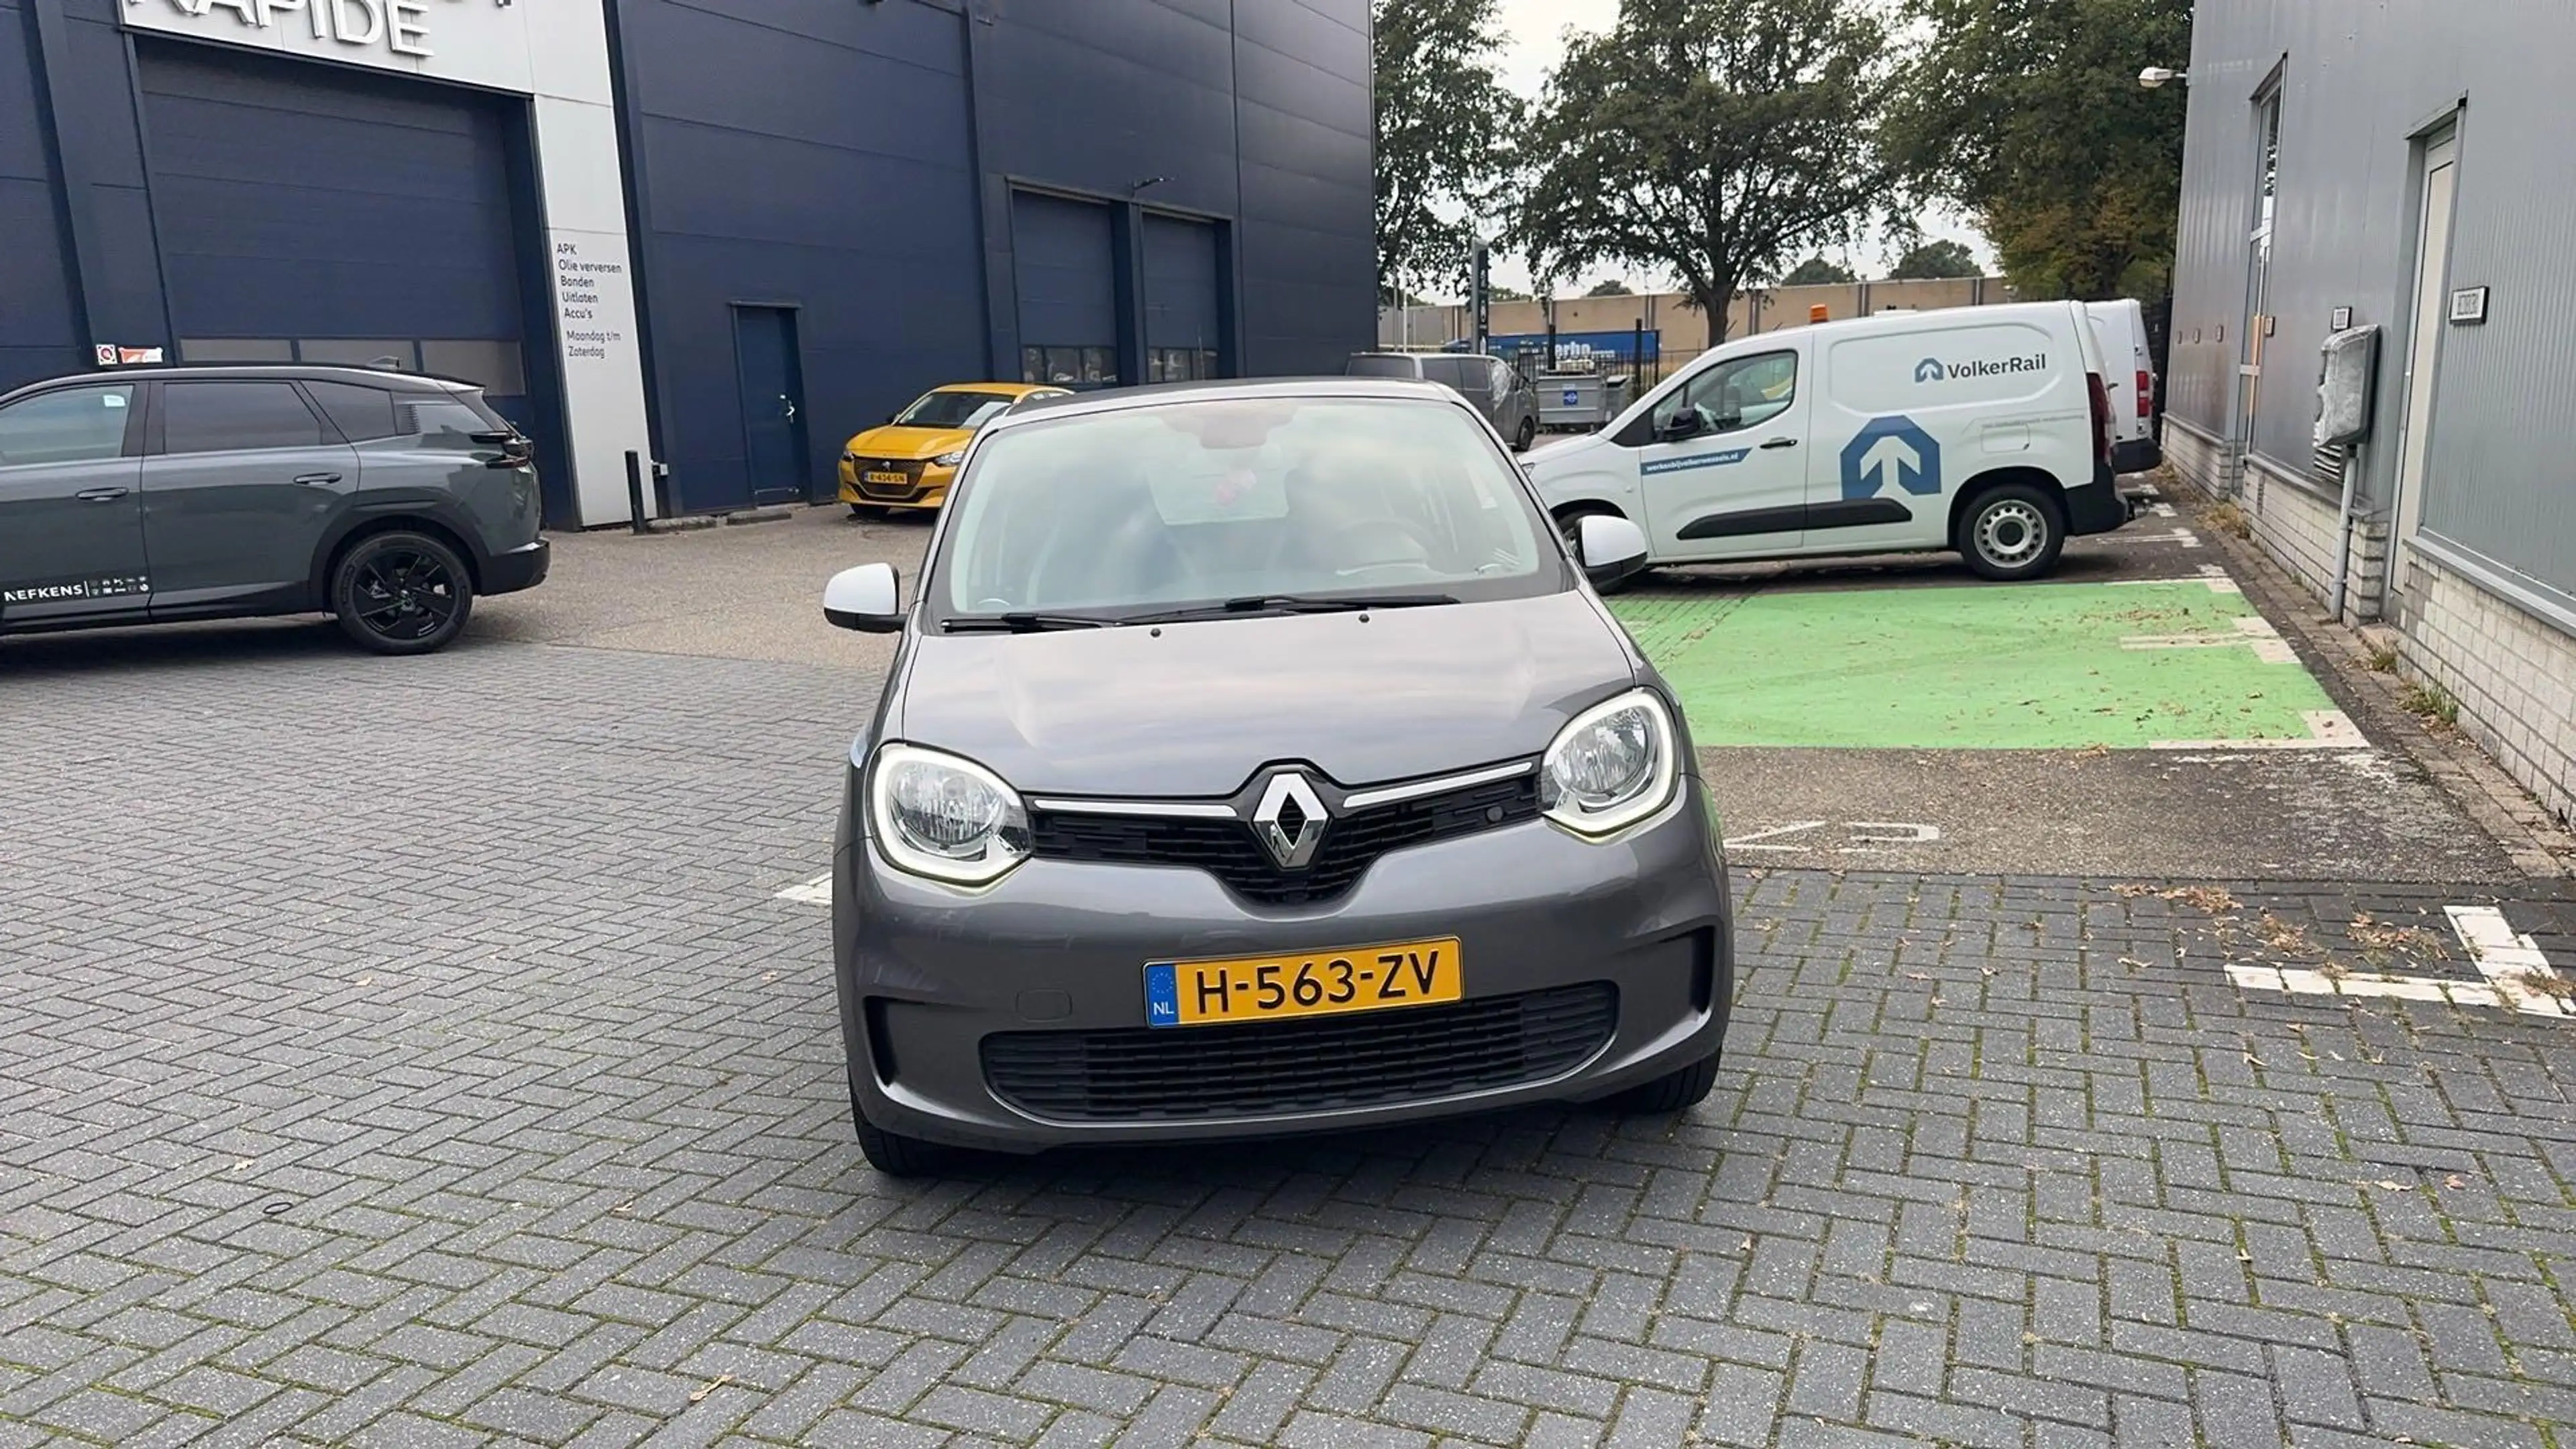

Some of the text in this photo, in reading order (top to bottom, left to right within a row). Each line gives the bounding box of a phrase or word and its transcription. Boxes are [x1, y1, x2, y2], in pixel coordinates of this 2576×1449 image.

[127, 0, 435, 56] APIDE
[557, 244, 577, 255] APK
[558, 259, 622, 273] Olie verversen
[561, 276, 594, 287] Banden
[562, 292, 598, 303] Uitlaten
[565, 308, 592, 319] Accu's
[567, 330, 621, 343] Maandag t/m
[569, 346, 604, 359] Zaterdag
[1947, 354, 2046, 379] VolkerRail
[4, 584, 83, 602] NEFKENS
[1197, 951, 1439, 1014] H-563-ZV
[1153, 1002, 1175, 1015] NL
